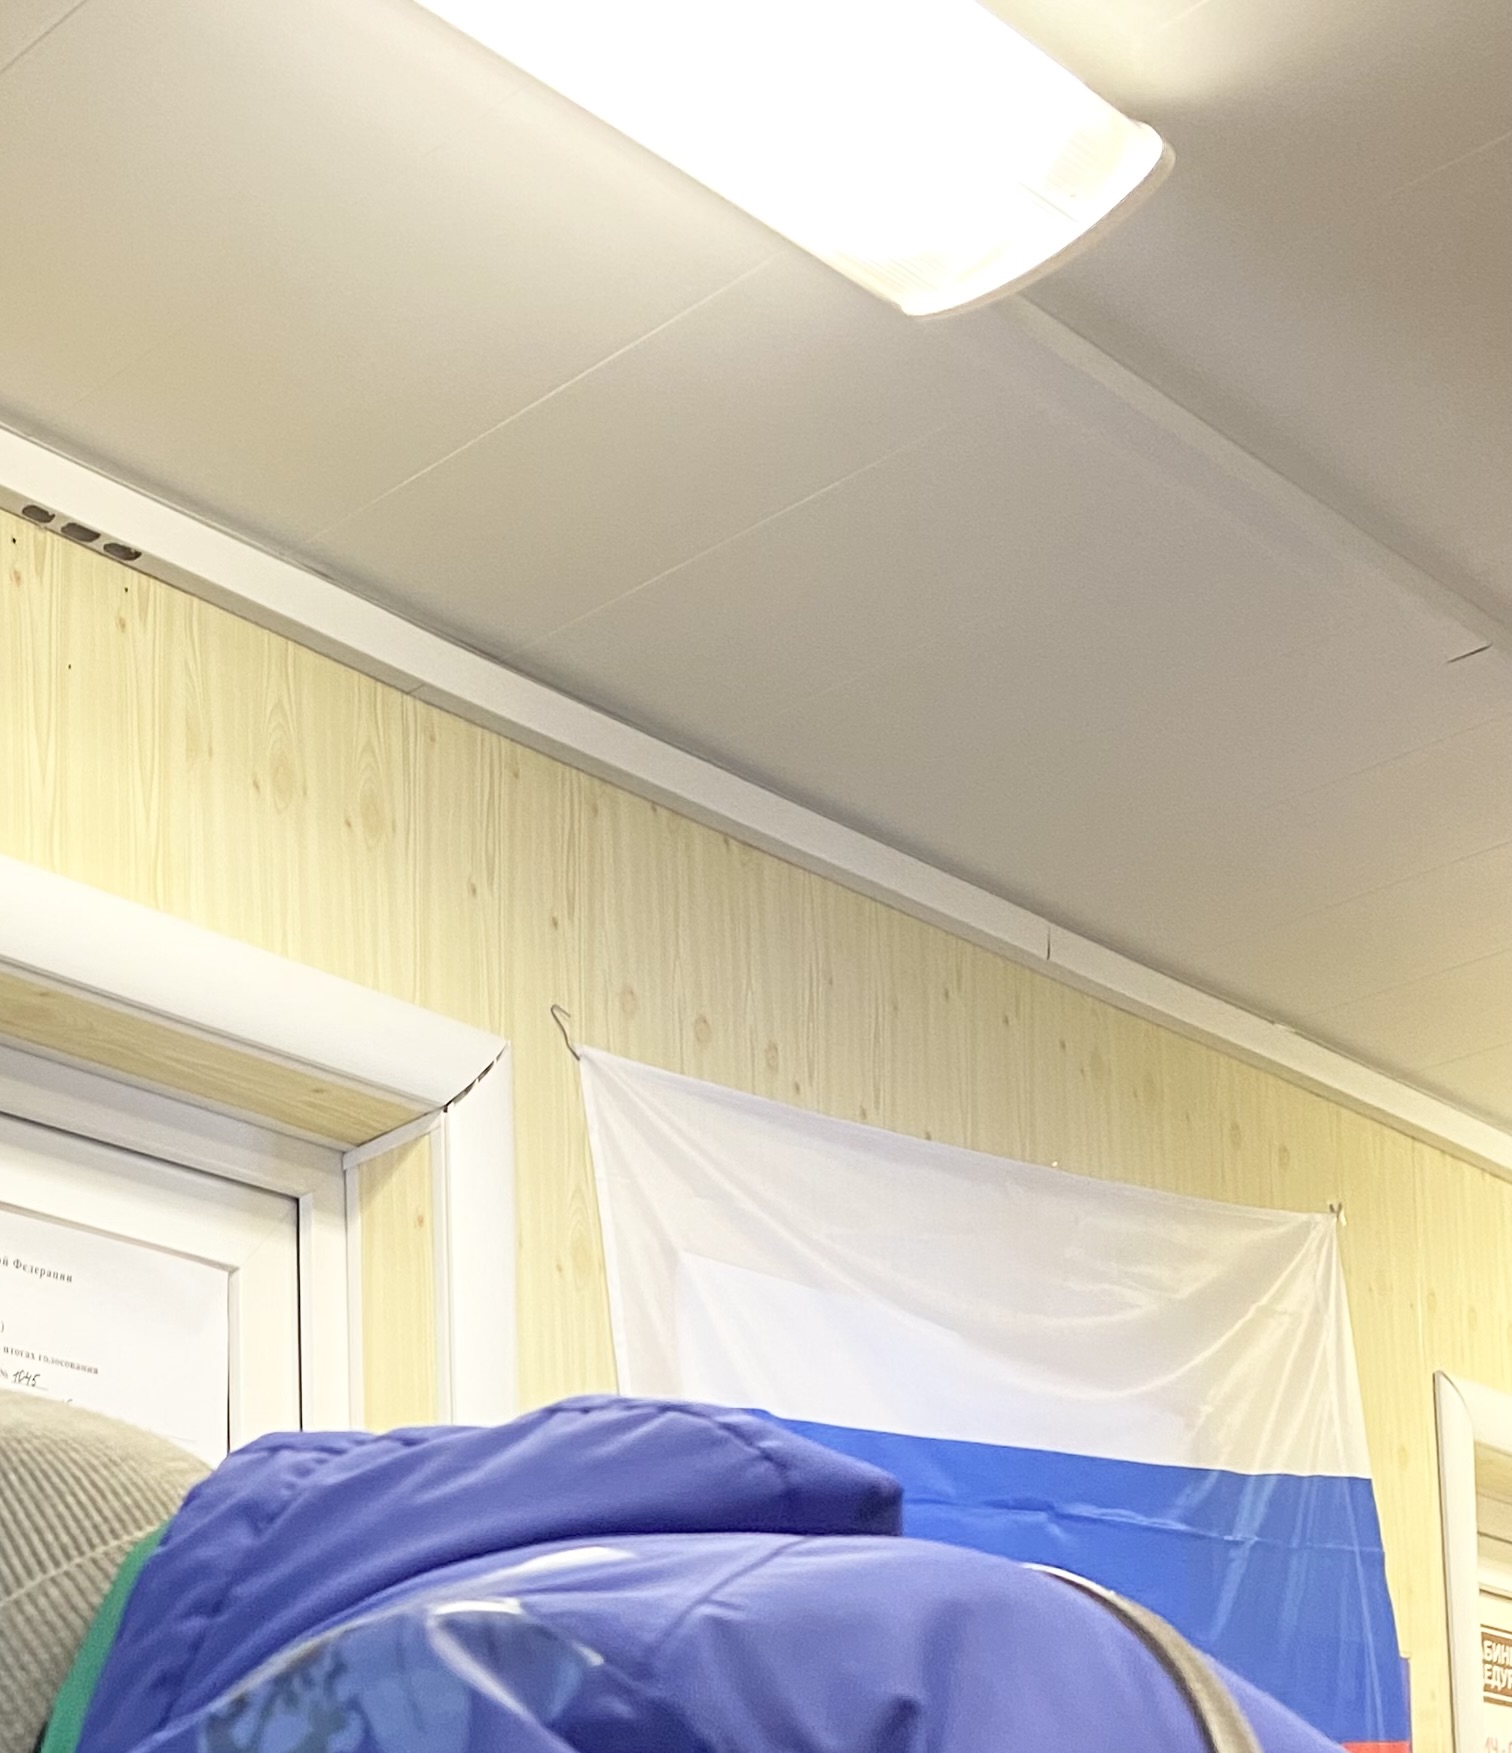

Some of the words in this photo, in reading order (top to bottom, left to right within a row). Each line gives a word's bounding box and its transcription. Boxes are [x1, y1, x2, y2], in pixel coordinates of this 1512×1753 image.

[13, 1259, 73, 1283] Федерации
[4, 1346, 35, 1360] итогах
[38, 1353, 99, 1375] голосования
